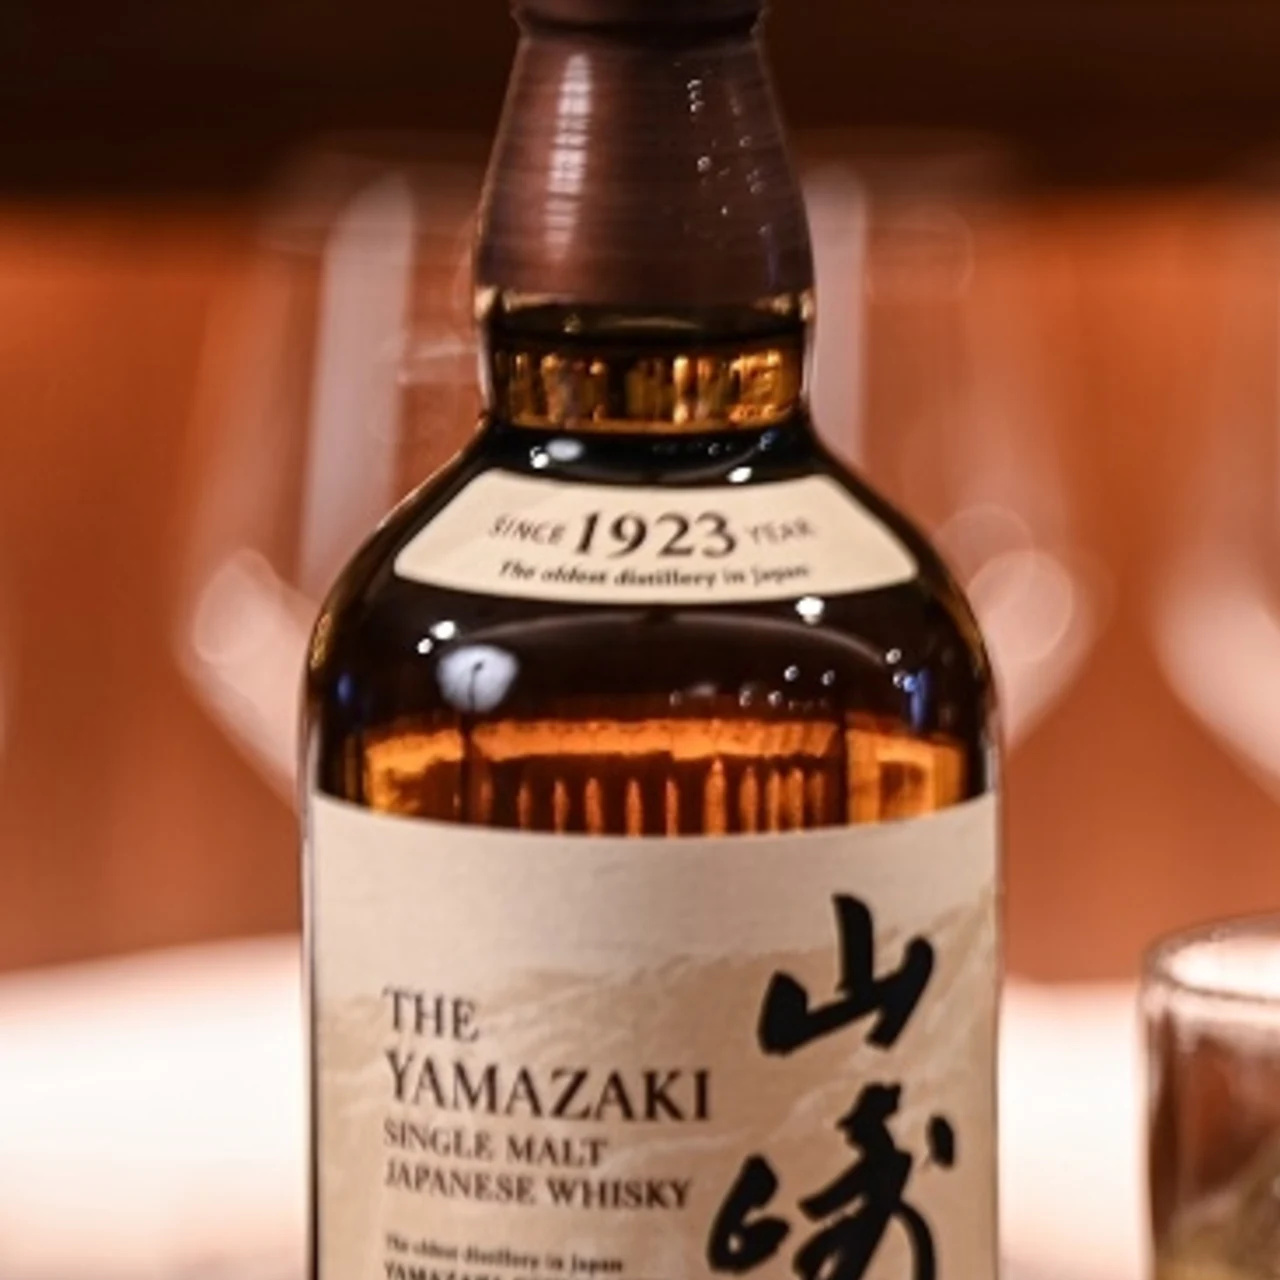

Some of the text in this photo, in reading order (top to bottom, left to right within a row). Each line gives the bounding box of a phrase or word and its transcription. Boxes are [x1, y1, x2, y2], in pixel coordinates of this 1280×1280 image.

[491, 511, 816, 560] SINCE 1923 YEAR
[500, 559, 536, 580] The
[541, 563, 606, 583] oldest
[614, 567, 716, 590] distillery
[722, 566, 745, 586] in
[383, 986, 481, 1043] THE
[384, 1048, 713, 1123] YAMAZAKI
[384, 1117, 608, 1168] SINGLE MALT
[384, 1158, 692, 1211] JAPANESE WHISKY
